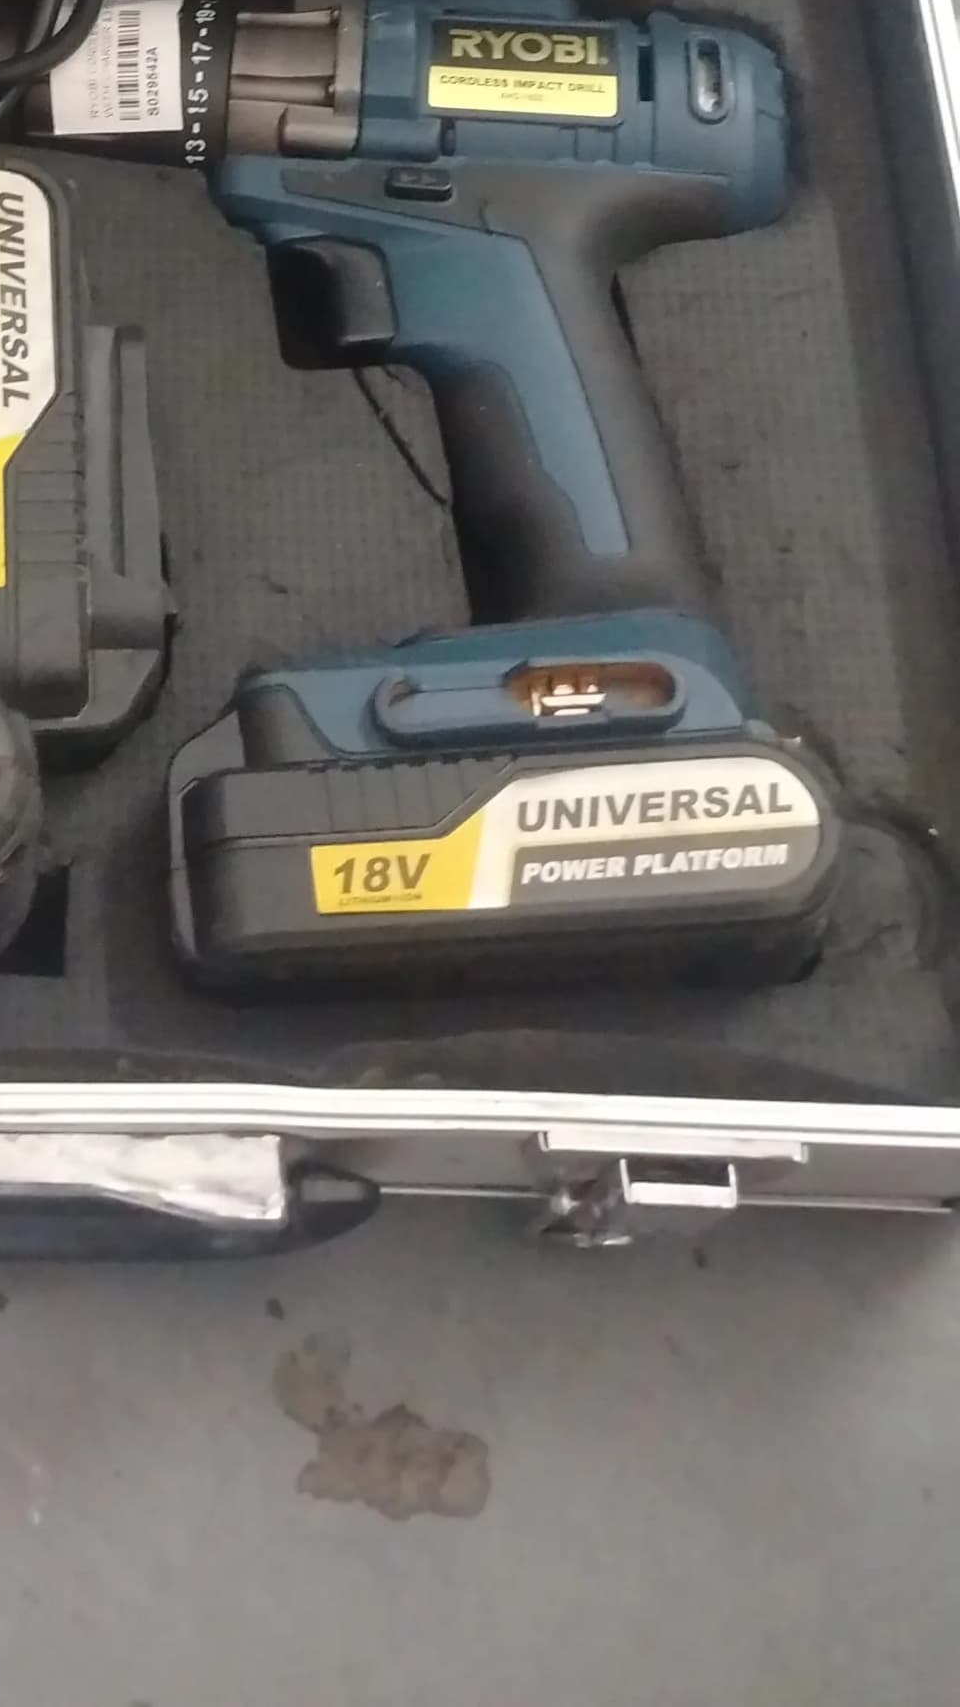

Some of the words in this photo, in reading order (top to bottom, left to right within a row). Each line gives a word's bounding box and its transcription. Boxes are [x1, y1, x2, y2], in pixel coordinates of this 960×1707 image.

[439, 74, 508, 89] CORDLESS
[513, 79, 563, 92] IMPACT
[568, 82, 606, 94] DRILL
[517, 781, 794, 834] UNIVERSAL
[332, 853, 431, 894] 18V
[520, 855, 625, 885] POWER
[632, 844, 789, 876] PLATFORM
